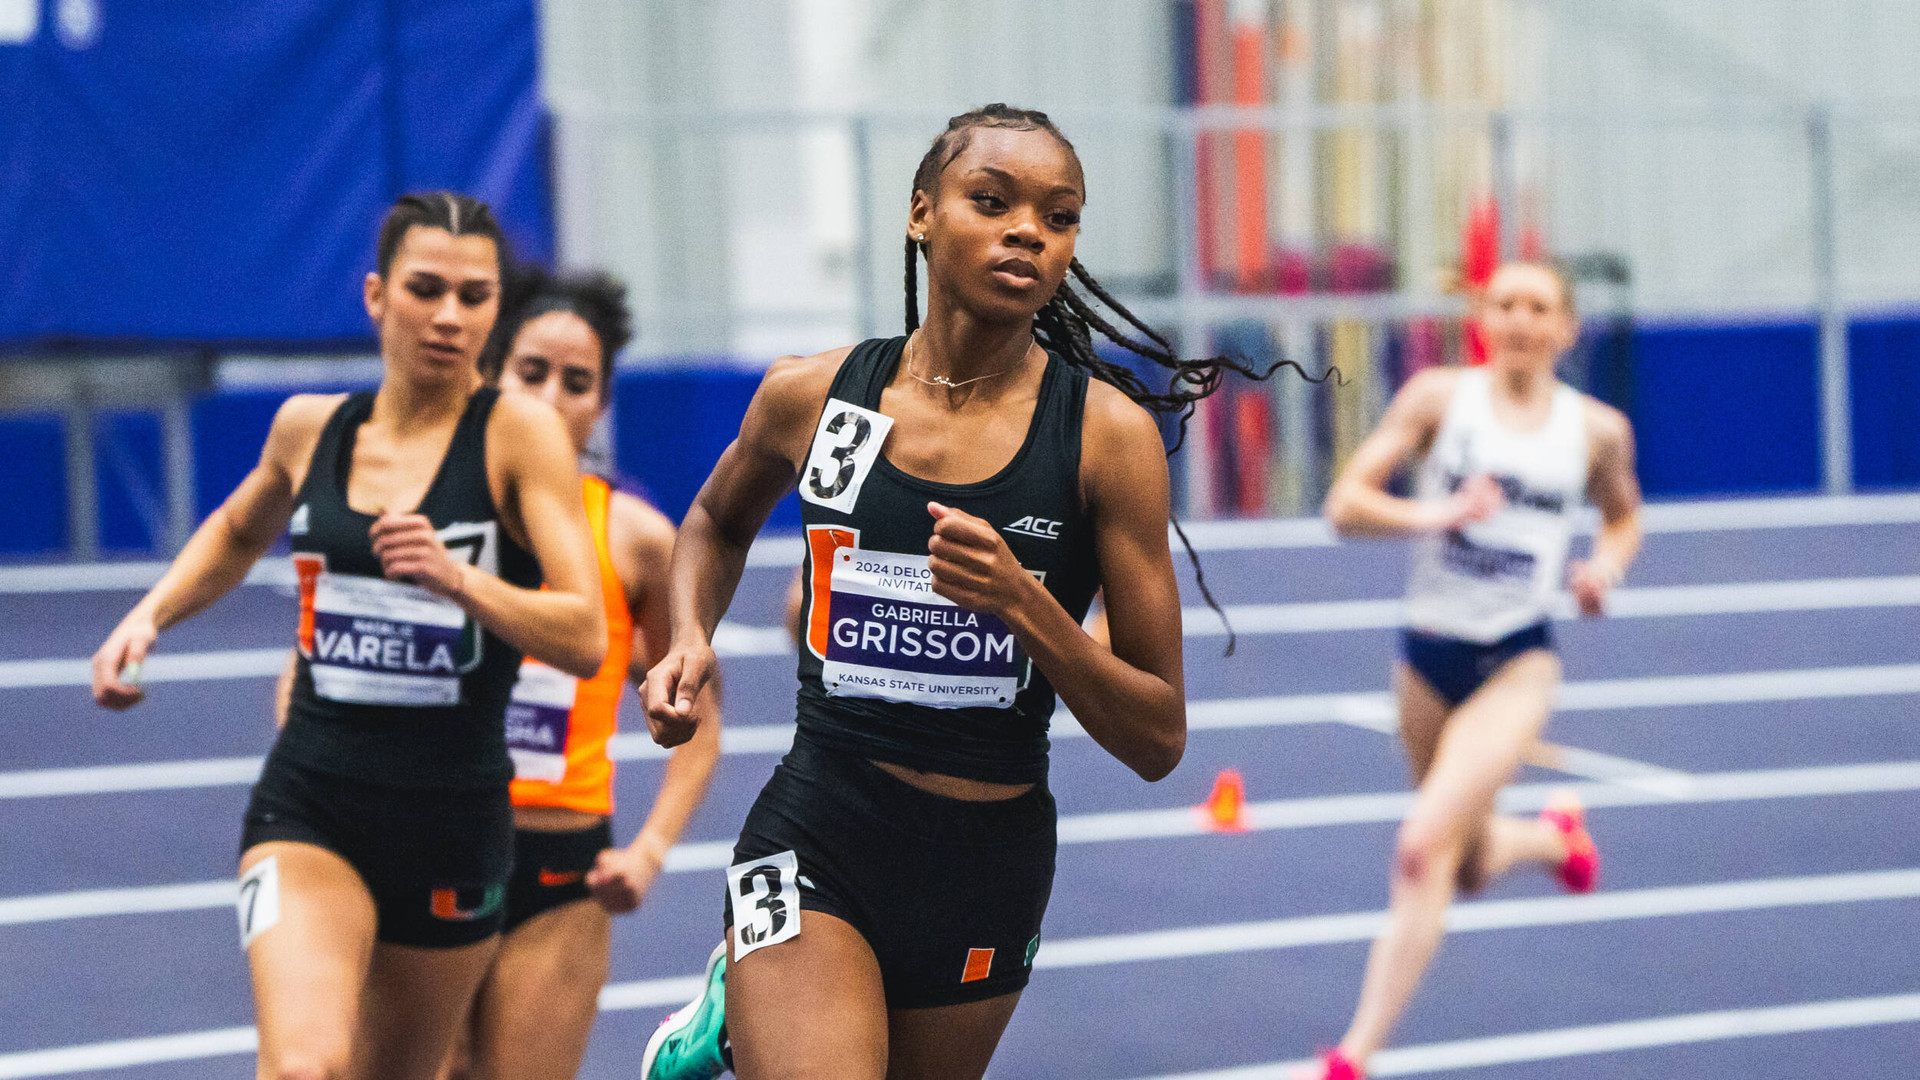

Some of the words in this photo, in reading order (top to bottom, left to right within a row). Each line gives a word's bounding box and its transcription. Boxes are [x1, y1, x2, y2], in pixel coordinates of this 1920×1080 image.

[808, 411, 872, 499] 3
[1009, 515, 1063, 536] ACC
[444, 533, 486, 567] 7
[855, 561, 889, 575] 2024
[893, 565, 931, 579] DELO
[878, 577, 932, 592] INVITAT
[871, 602, 979, 628] GABRIELLA
[314, 628, 455, 672] VARELA
[832, 617, 1015, 663] GRISSOM
[838, 673, 886, 688] KANSAS
[889, 679, 925, 692] STATE
[928, 683, 1000, 695] UNIVERSITY
[240, 870, 265, 934] 7
[739, 864, 788, 946] 3
